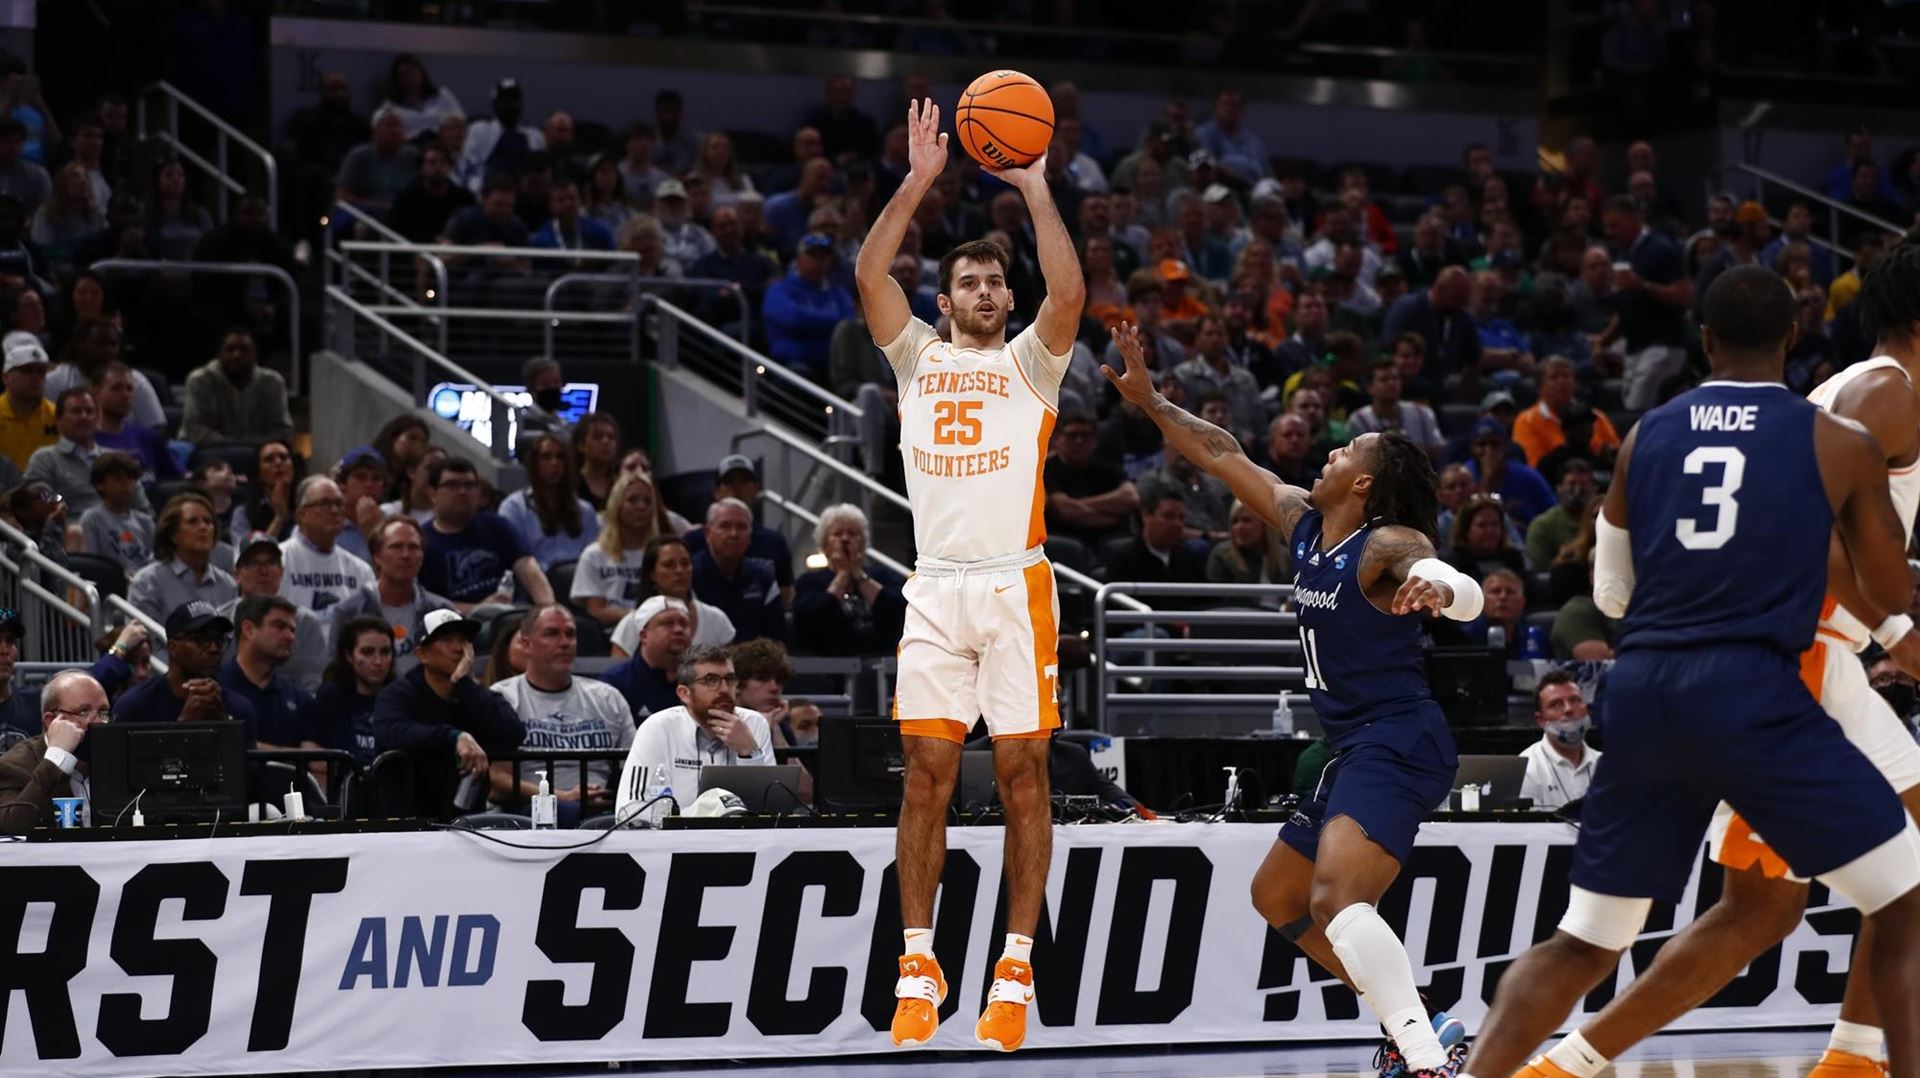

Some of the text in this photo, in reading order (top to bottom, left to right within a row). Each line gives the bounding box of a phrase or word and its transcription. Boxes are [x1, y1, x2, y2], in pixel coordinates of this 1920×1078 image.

[917, 371, 1010, 399] TENNESSEE
[933, 400, 983, 446] 25
[1690, 405, 1759, 431] WADE
[912, 445, 1010, 477] VOLUNTEERS
[1675, 446, 1747, 550] 3
[1299, 625, 1329, 691] 11
[339, 914, 501, 990] AND
[521, 846, 1214, 1042] SECOND
